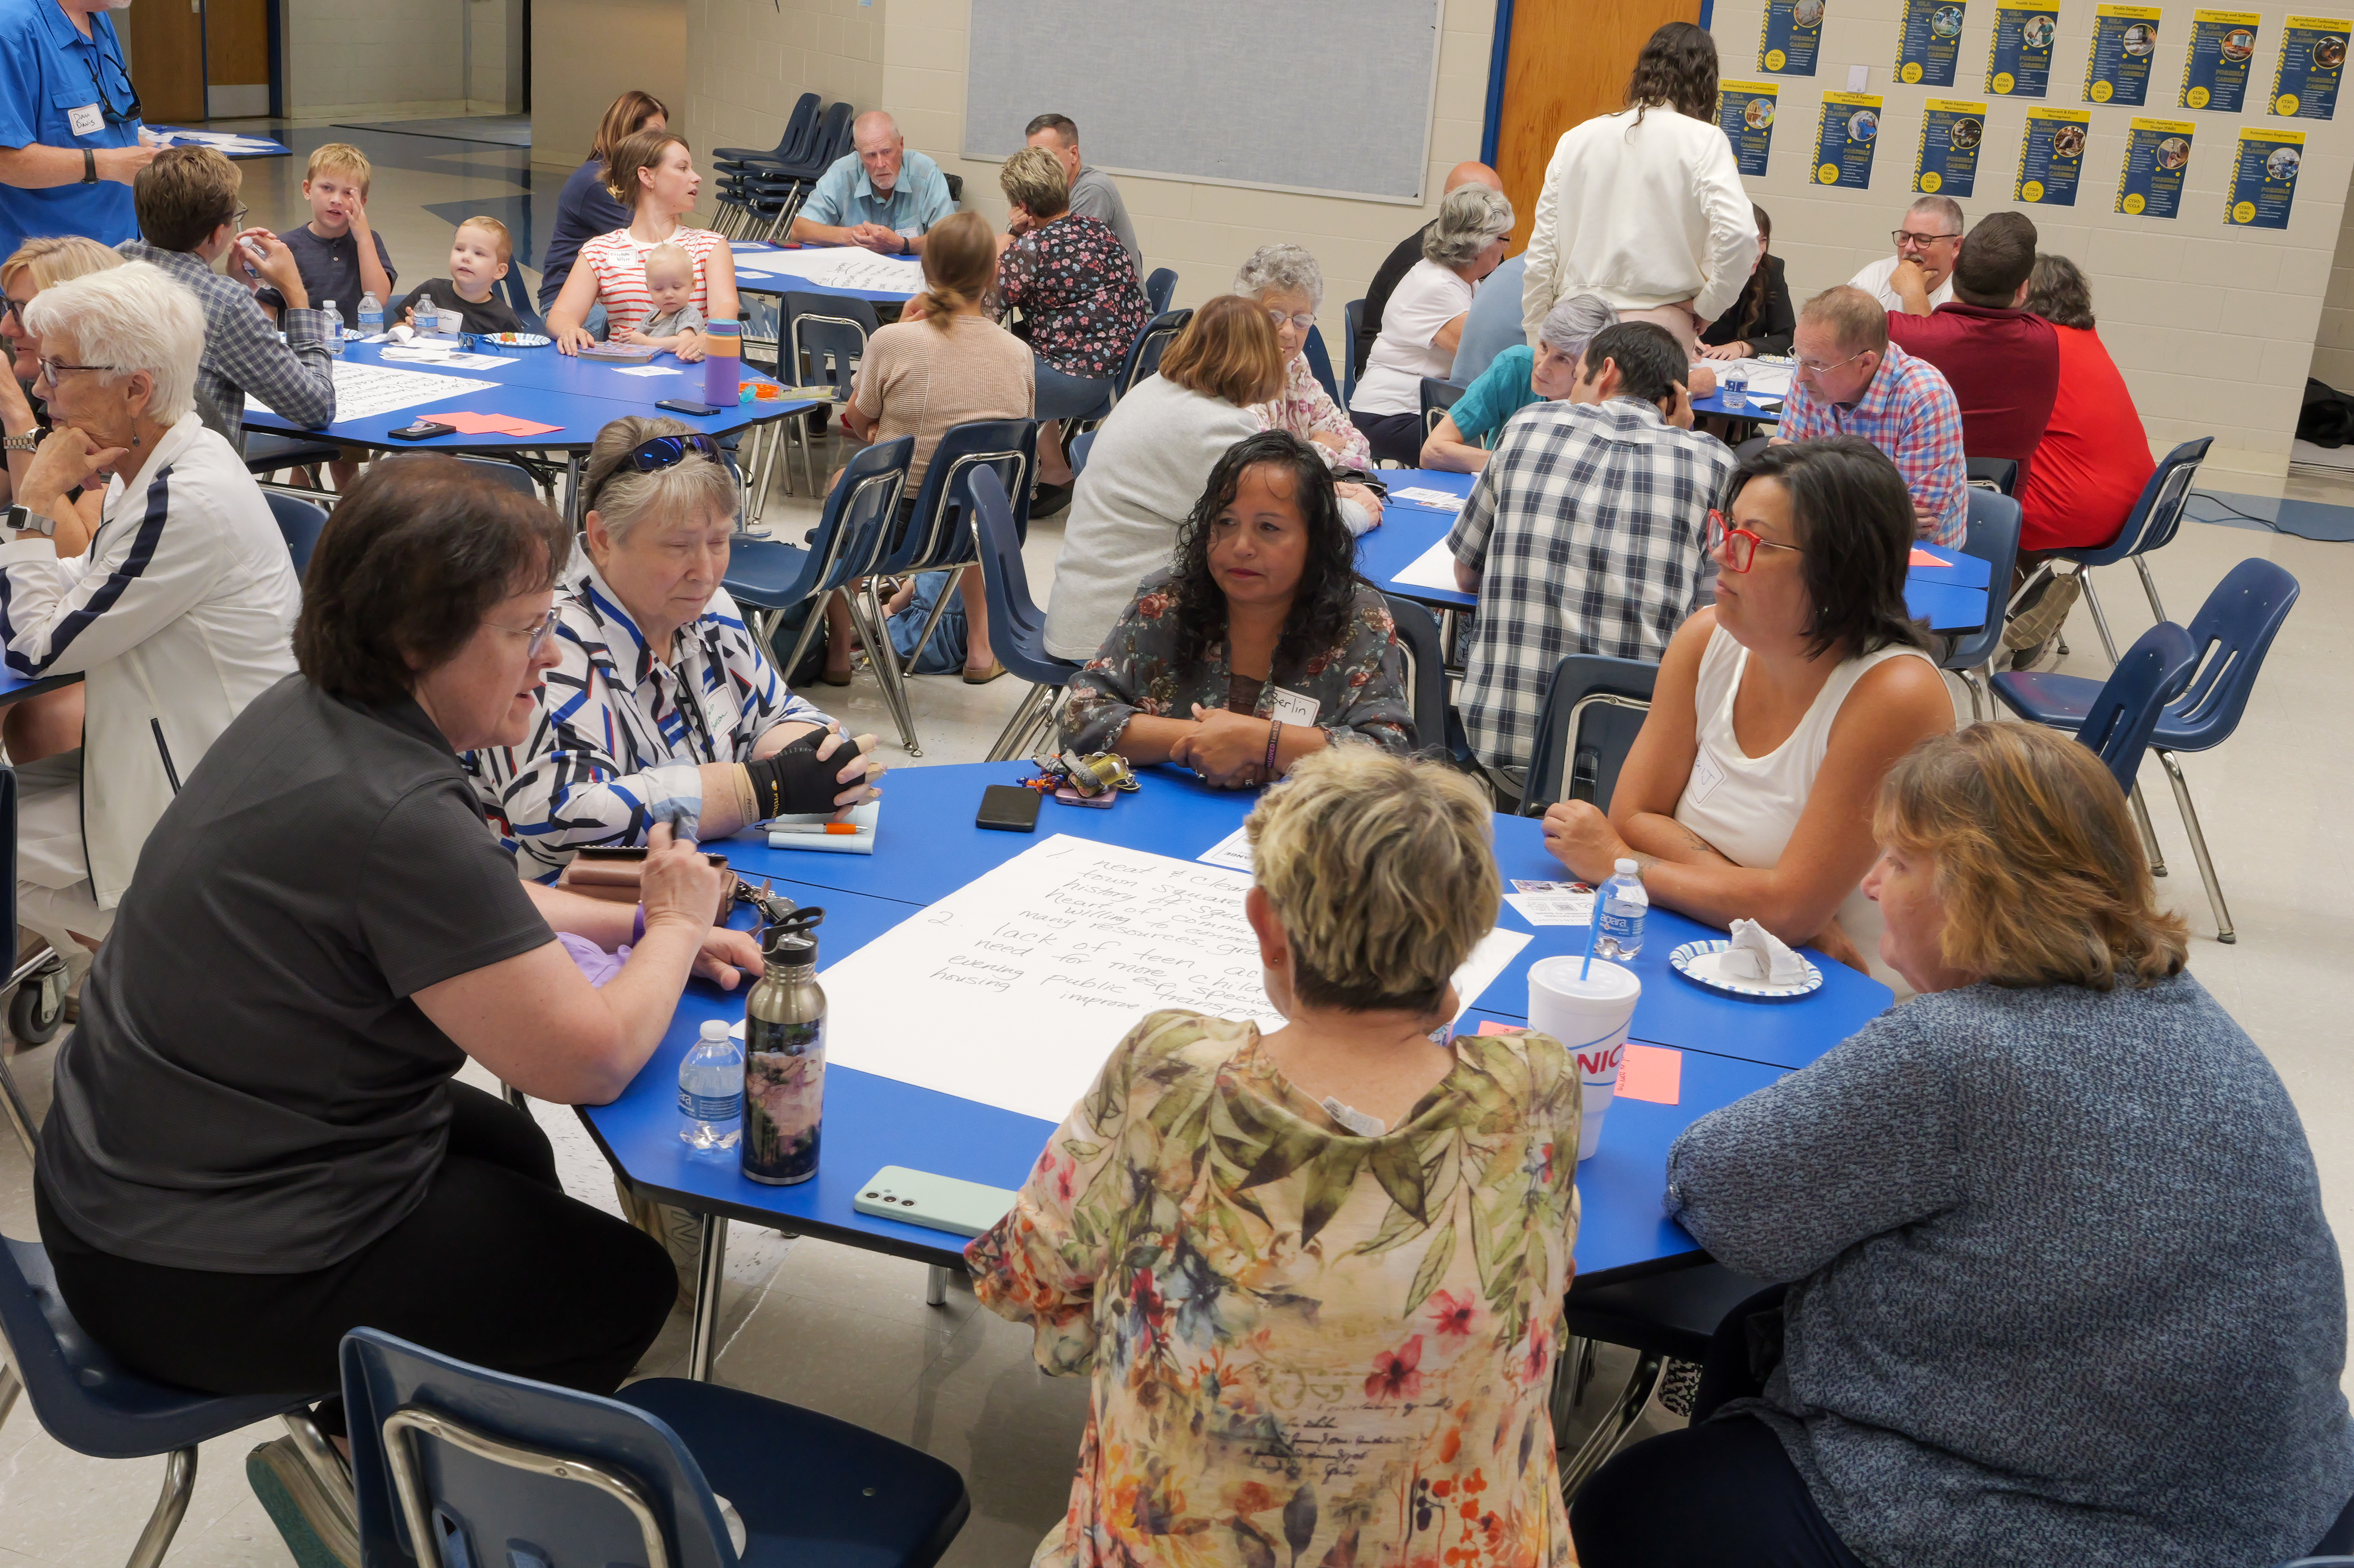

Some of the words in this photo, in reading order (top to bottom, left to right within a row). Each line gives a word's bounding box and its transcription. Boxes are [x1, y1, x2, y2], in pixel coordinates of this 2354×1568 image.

[74, 113, 90, 122] Dan
[76, 119, 95, 128] Davis
[1273, 692, 1306, 716] Berlin
[1267, 743, 1275, 762] LOVED
[1078, 869, 1137, 887] town
[1045, 888, 1114, 909] heart
[1124, 907, 1162, 915] of
[1062, 879, 1137, 902] history
[1018, 910, 1076, 929] many
[1146, 920, 1170, 928] to
[1600, 914, 1627, 928] agara
[992, 922, 1057, 945] lack
[1073, 941, 1121, 952] of
[1133, 949, 1195, 968] teen
[948, 956, 1024, 980] evening
[974, 940, 1034, 957] need
[1051, 953, 1092, 964] for
[1109, 962, 1167, 977] more
[930, 967, 1011, 992] housing
[1577, 1043, 1623, 1075] NIC
